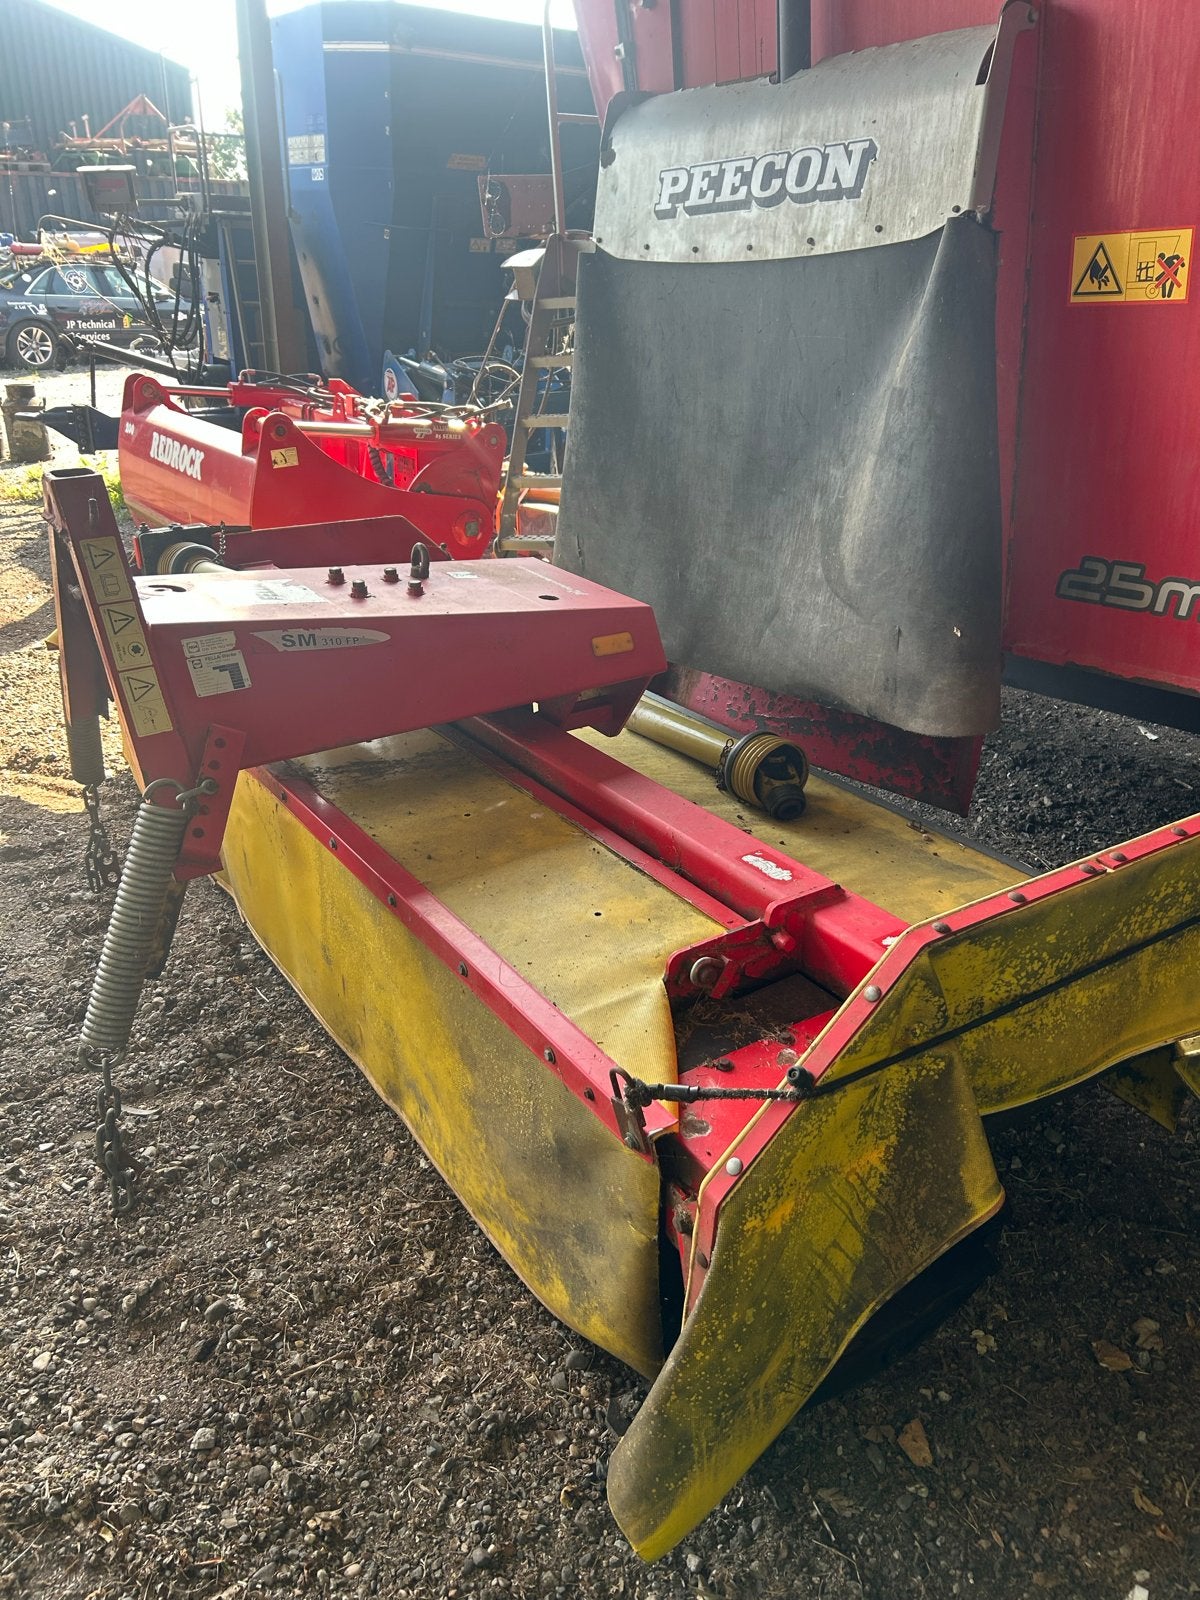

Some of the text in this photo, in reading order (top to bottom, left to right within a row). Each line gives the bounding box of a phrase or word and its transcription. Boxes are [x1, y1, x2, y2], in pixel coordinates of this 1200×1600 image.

[654, 138, 878, 220] PEECON
[66, 320, 116, 329] JP Technical
[149, 431, 205, 481] REDROCK
[281, 633, 360, 648] SM 310 FP
